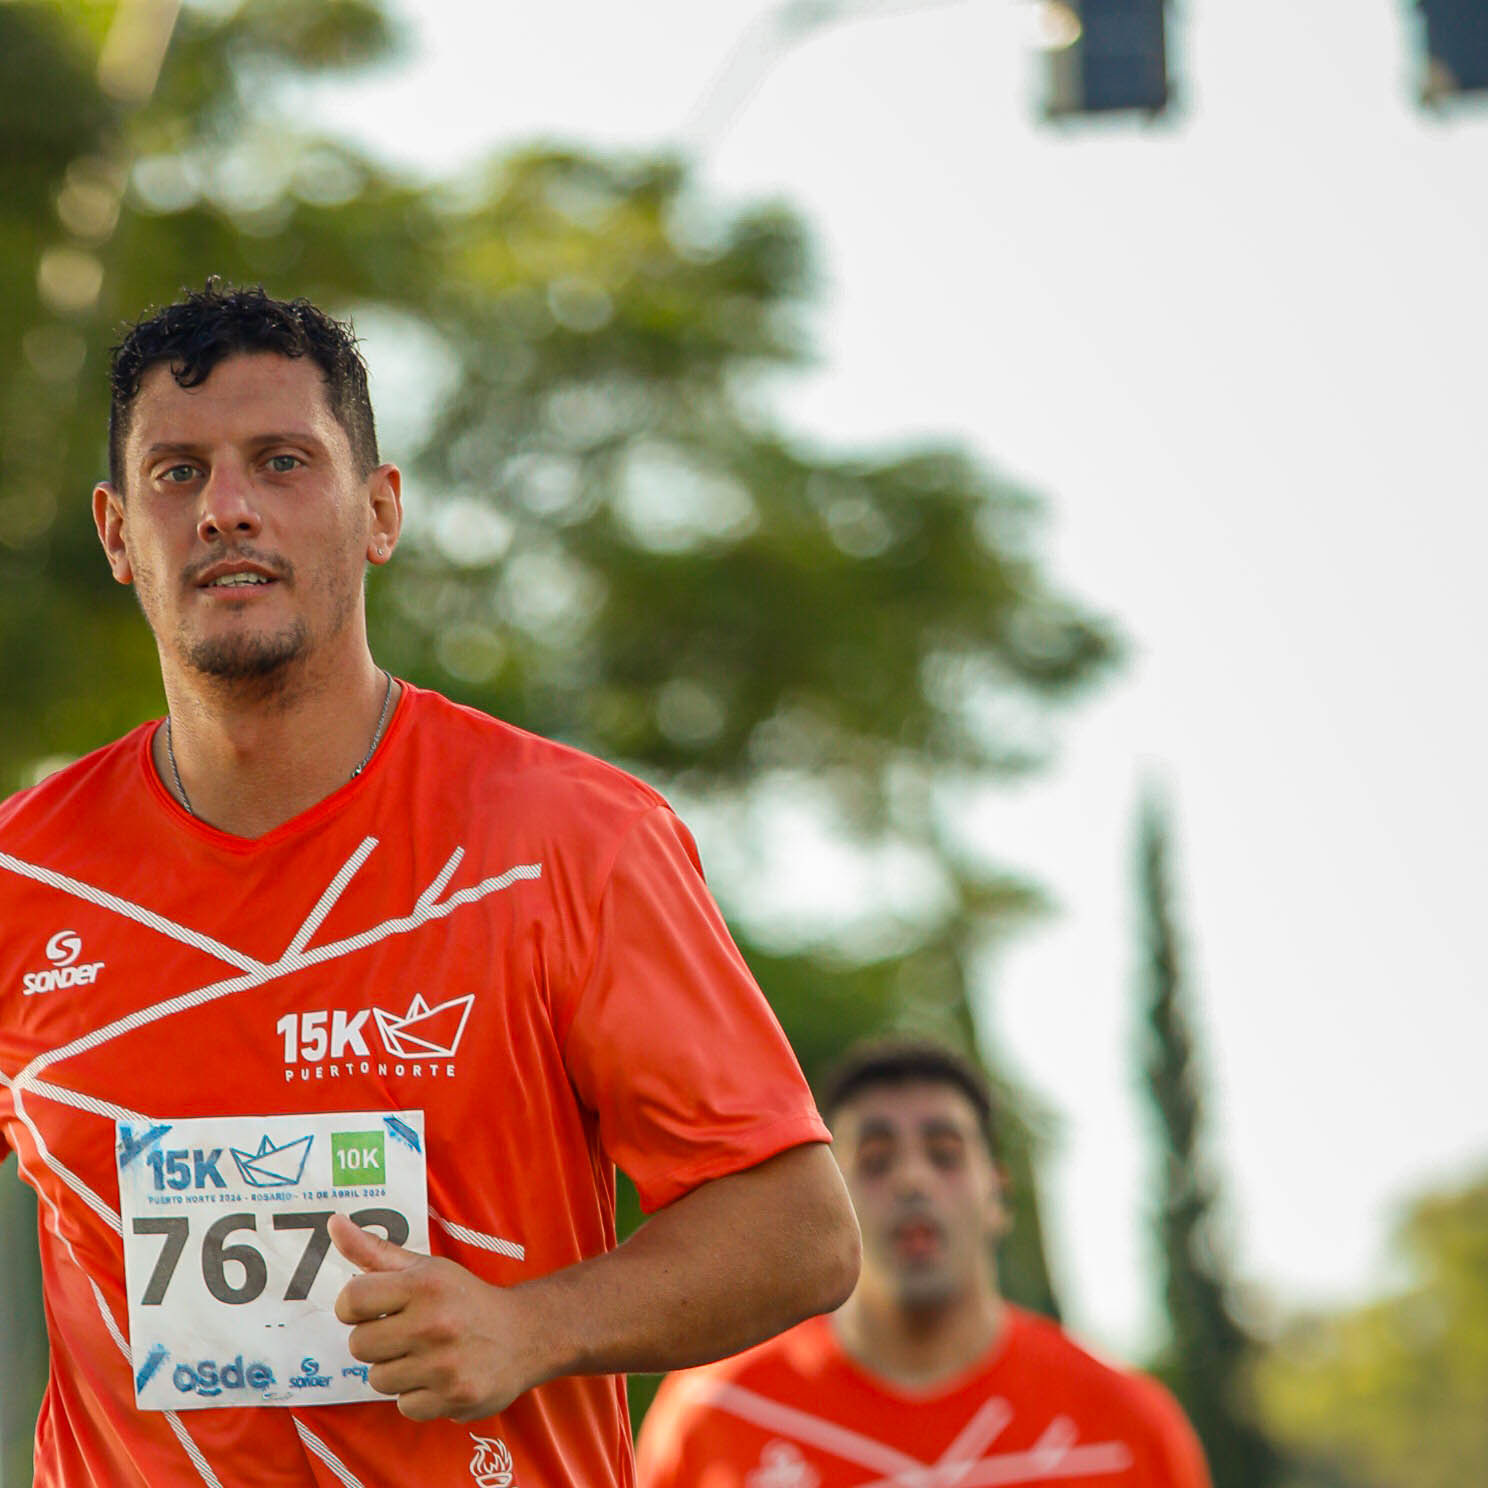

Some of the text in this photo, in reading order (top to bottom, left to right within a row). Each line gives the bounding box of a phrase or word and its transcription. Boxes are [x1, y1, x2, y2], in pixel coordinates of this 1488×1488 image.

[276, 1010, 371, 1063] 15K
[146, 1149, 226, 1190] 15K
[337, 1149, 380, 1170] 10K
[303, 1191, 313, 1200] 12
[316, 1190, 329, 1200] DE
[332, 1188, 360, 1199] ABRIL
